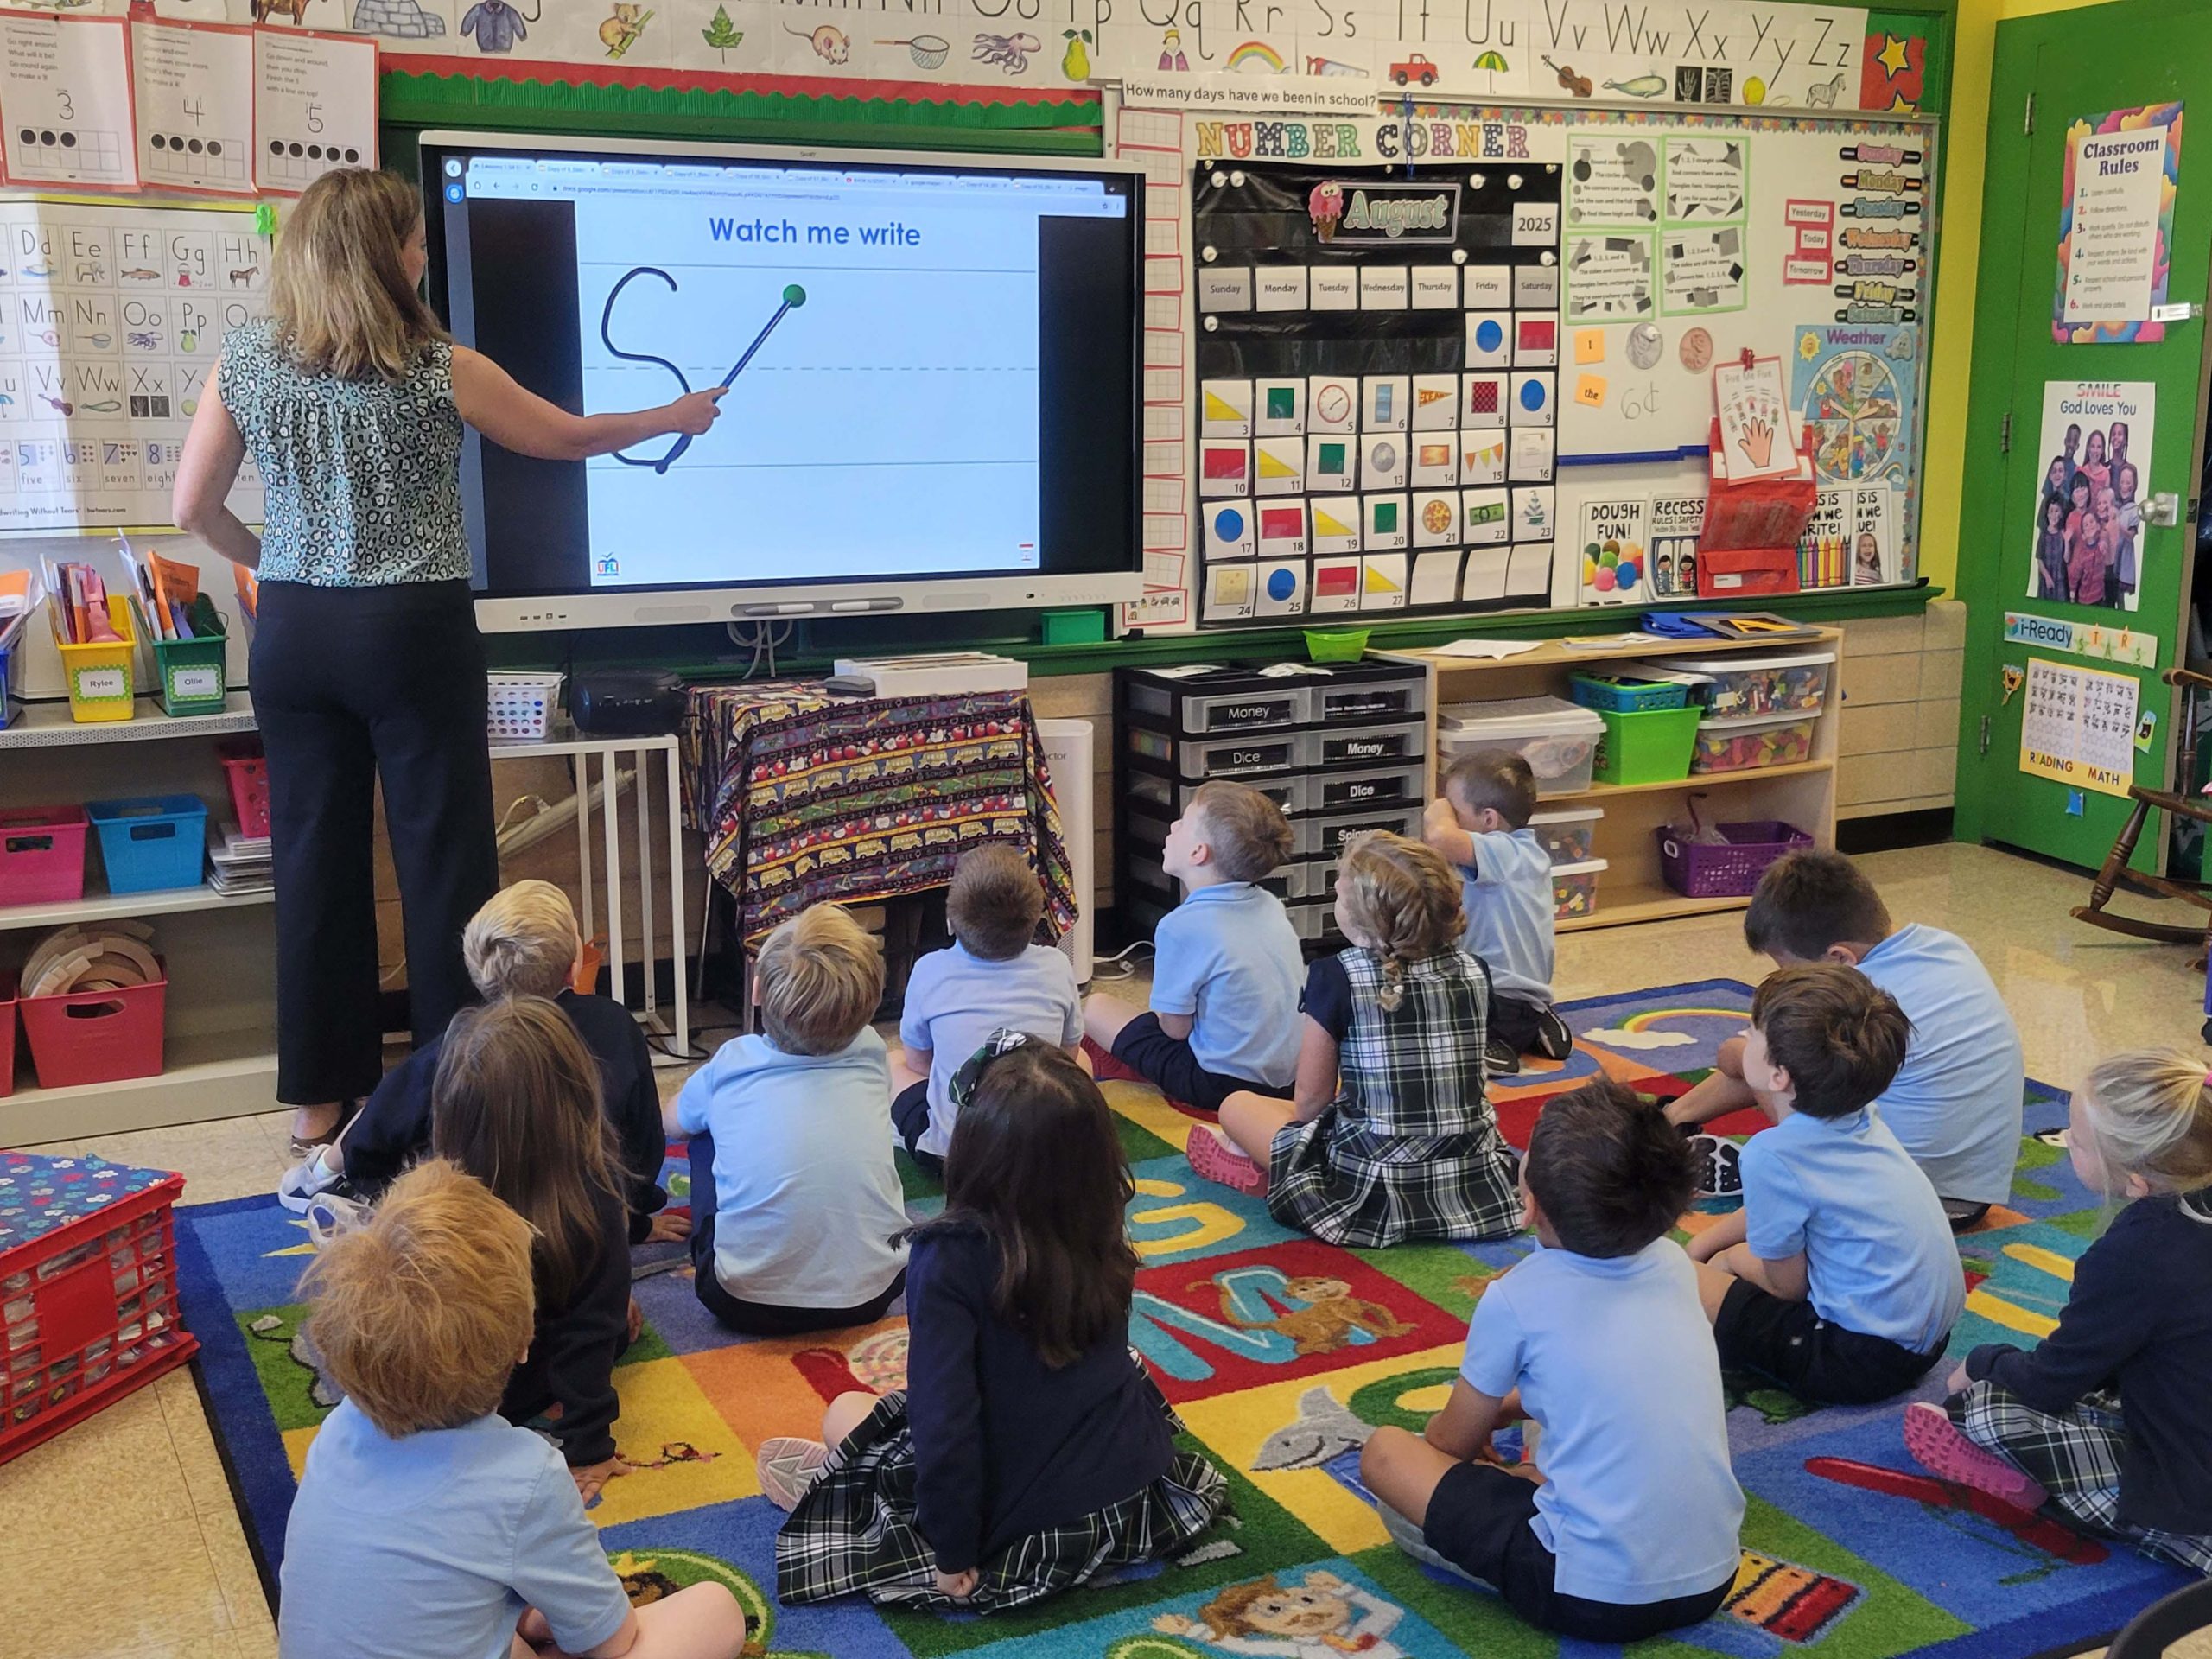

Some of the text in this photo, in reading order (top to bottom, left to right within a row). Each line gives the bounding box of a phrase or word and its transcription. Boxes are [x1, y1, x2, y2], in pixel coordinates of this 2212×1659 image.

[1544, 0, 1587, 51] Vv
[1604, 3, 1670, 56] Ww
[1681, 8, 1728, 61] Xx
[1748, 13, 1796, 90] Yy
[1808, 17, 1851, 67] Zz
[1126, 84, 1376, 108] How many days have we been in school?
[57, 92, 75, 121] 3
[183, 97, 205, 127] 4
[308, 106, 324, 133] 5
[1196, 121, 1530, 159] NUMBER CORNER
[2083, 138, 2160, 160] Classroom
[2098, 159, 2140, 176] Rules
[2079, 187, 2088, 198] 1.
[1343, 189, 1449, 238] August
[1791, 207, 1827, 220] Yesterday
[2077, 206, 2088, 215] 2.
[709, 216, 921, 247] Watch me write
[1517, 217, 1553, 232] 2025
[2076, 223, 2087, 234] 3.
[1803, 234, 1825, 245] Today
[21, 229, 259, 276] Dd Ee Ff Gg Hh
[2075, 248, 2085, 259] 4.
[1789, 264, 1824, 276] Tomorrow
[2072, 275, 2082, 286] 5.
[1210, 282, 1553, 296] Sunday Monday Tuesday Wednesday Thursday Friday Saturday
[2069, 299, 2079, 310] 6.
[23, 298, 207, 341] Mm Nn Oo Pp
[1827, 328, 1887, 346] Weather
[1548, 354, 1555, 364] 2
[35, 365, 163, 392] Vv Ww Xx
[1584, 388, 1599, 400] the
[2077, 383, 2121, 397] SMILE
[2060, 400, 2137, 416] God Loves You
[1242, 414, 1552, 435] 3 4 5 6 7 8 9
[18, 443, 161, 467] 5 6 7 8
[22, 474, 42, 485] five
[66, 474, 82, 484] six
[1234, 469, 1550, 493] 10 11 12 13 14 15 16
[30, 506, 60, 516] Without
[1596, 524, 1631, 540] FUN!
[1241, 527, 1552, 553] 17 18 19 20 21 22 23
[597, 561, 620, 574] UFLI
[1237, 595, 1403, 616] 24 25 26 27
[2020, 620, 2073, 648] i-Ready
[90, 678, 114, 690] Rylee
[184, 677, 203, 687] Ollie
[1228, 705, 1271, 720] Money
[1347, 743, 1384, 756] Money
[1233, 752, 1261, 765] Dice
[2088, 767, 2120, 786] MATH
[1350, 785, 1375, 798] Dice
